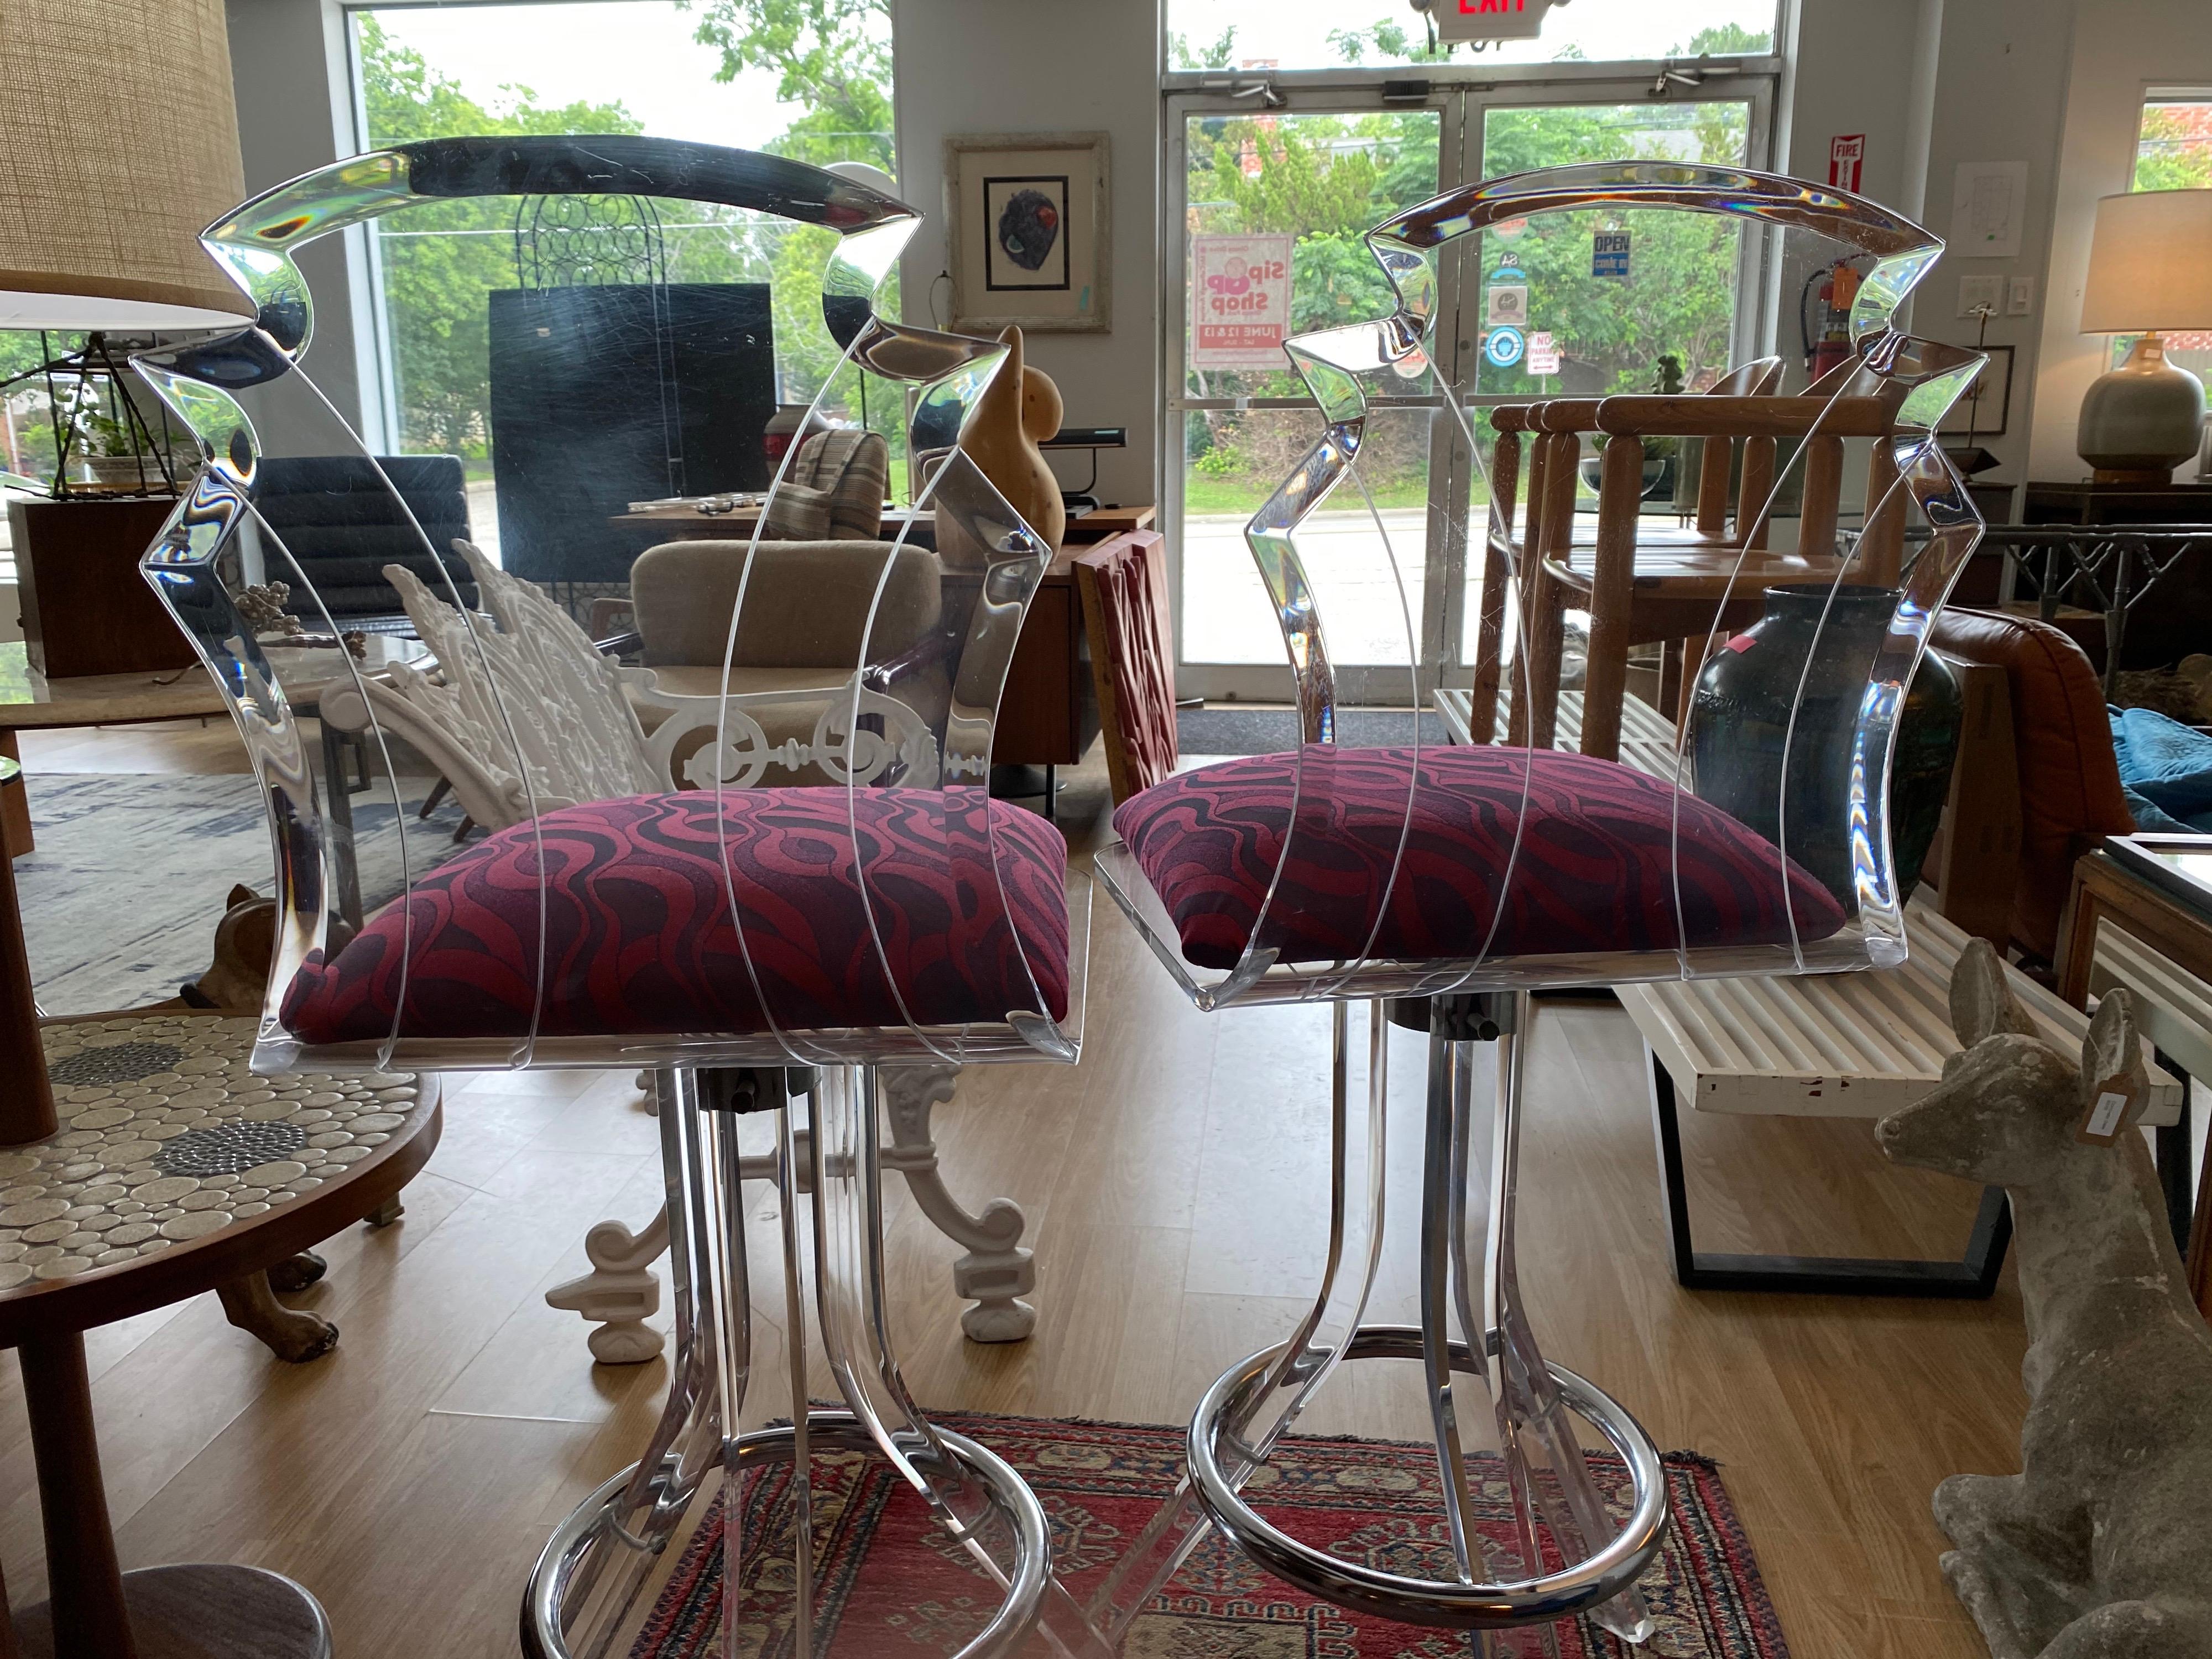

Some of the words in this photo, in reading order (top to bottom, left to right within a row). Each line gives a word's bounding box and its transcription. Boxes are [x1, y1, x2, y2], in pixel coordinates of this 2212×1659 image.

[1836, 144, 1859, 157] FIRE
[1595, 236, 1630, 252] OPEN
[1538, 335, 1551, 345] NO
